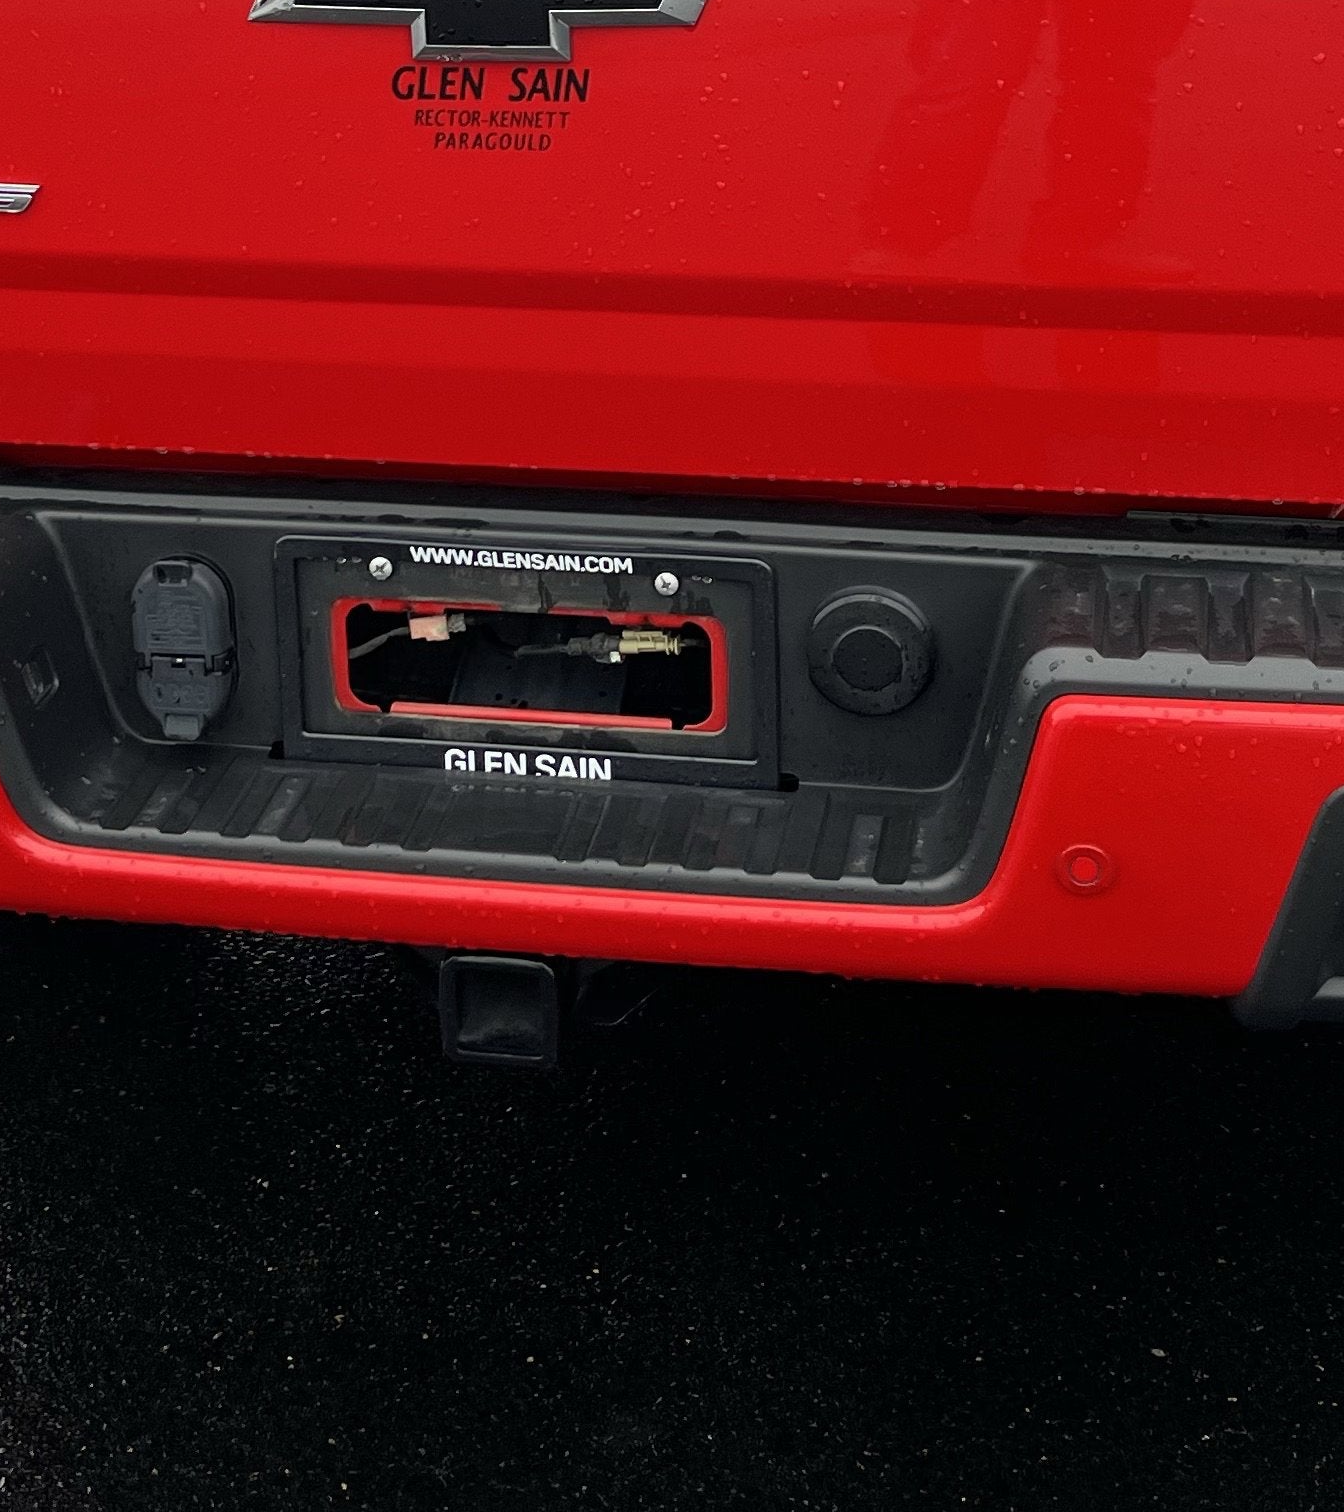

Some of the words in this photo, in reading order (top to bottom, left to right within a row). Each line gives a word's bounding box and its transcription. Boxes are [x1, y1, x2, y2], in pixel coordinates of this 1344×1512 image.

[392, 66, 484, 101] GLEN
[508, 67, 591, 103] SAIN
[414, 109, 571, 130] RECTOR-KENNETT
[433, 132, 552, 152] PARAGOULD
[409, 545, 634, 575] WWW.GLENSAIN.COM
[444, 747, 528, 776] GLEN
[534, 753, 612, 781] SAIN
